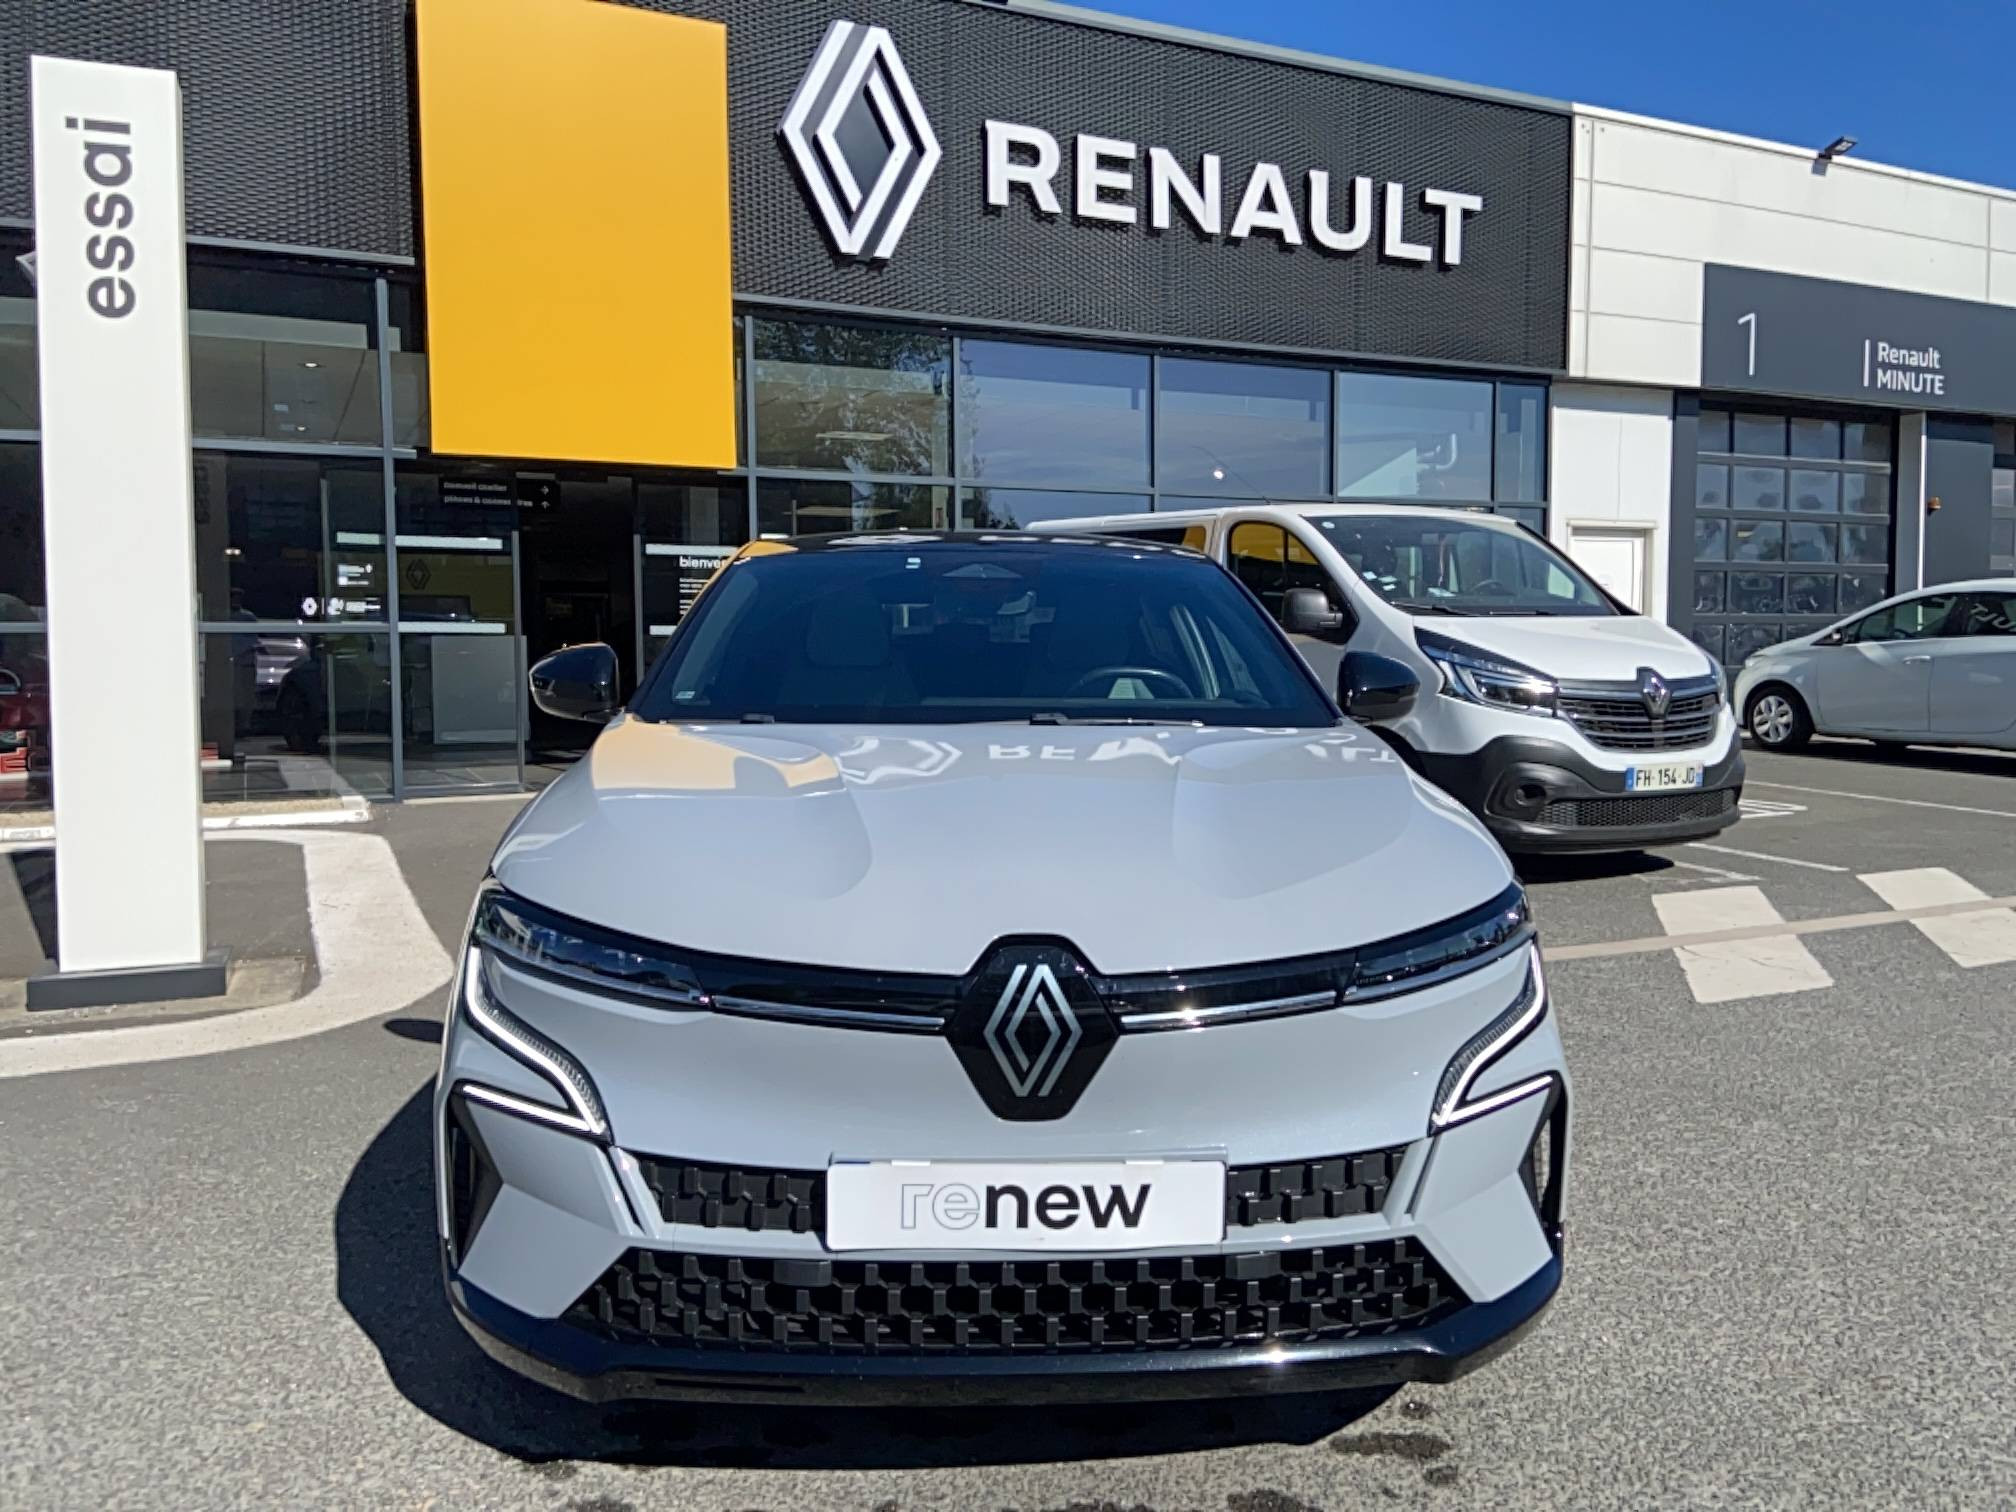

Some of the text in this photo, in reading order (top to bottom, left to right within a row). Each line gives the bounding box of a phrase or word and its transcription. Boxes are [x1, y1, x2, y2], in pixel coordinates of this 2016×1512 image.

[984, 118, 1484, 266] RENAULT
[64, 116, 137, 319] essai
[1876, 341, 1942, 370] Renault
[1876, 367, 1946, 396] MINUTE
[900, 1182, 1152, 1231] renew
